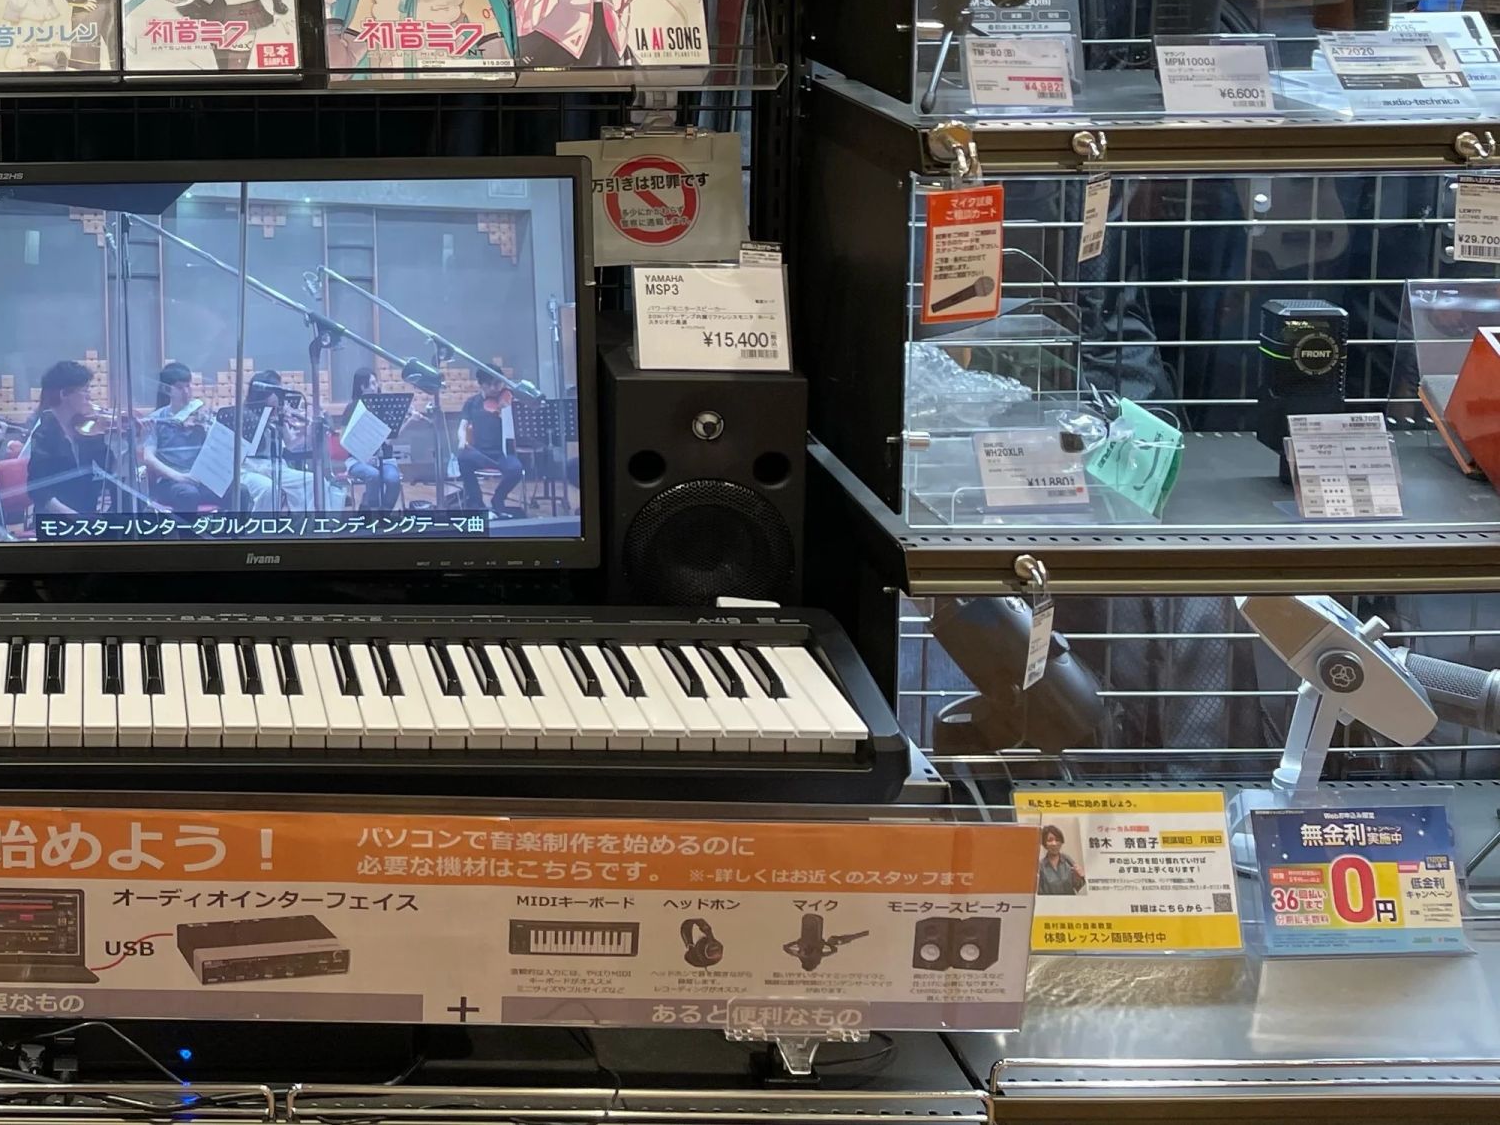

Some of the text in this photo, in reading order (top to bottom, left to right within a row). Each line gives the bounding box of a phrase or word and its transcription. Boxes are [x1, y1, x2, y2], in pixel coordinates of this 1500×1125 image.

[143, 18, 250, 52] 初音ミク
[357, 20, 486, 55] 初音ミク
[636, 27, 701, 50] IA AI SONG
[1219, 88, 1260, 100] ¥6,600
[592, 172, 709, 193] 万引きは犯罪です
[646, 285, 679, 295] MSP3
[703, 332, 768, 348] ¥15,400
[1301, 350, 1333, 359] FRONT
[40, 517, 295, 536] モンスターハンターダブルクロス
[313, 516, 485, 535] エンディングテーマ曲
[357, 827, 755, 857] パソコンで音楽制作を始めるのに
[1089, 837, 1112, 849] 鈴木
[1300, 823, 1366, 846] 無金利
[356, 853, 662, 882] 必要な機材はこちらです。
[1329, 854, 1397, 924] 0 円
[112, 888, 419, 913] オーディオインターフェイス
[516, 894, 636, 909] MIDIキーボード
[662, 897, 741, 911] ヘッドホン
[792, 898, 840, 912] マイク
[886, 899, 1027, 914] モニタースピーカー
[1271, 887, 1299, 912] 36
[105, 940, 155, 958] USB
[651, 1003, 864, 1026] あると便利なもの
